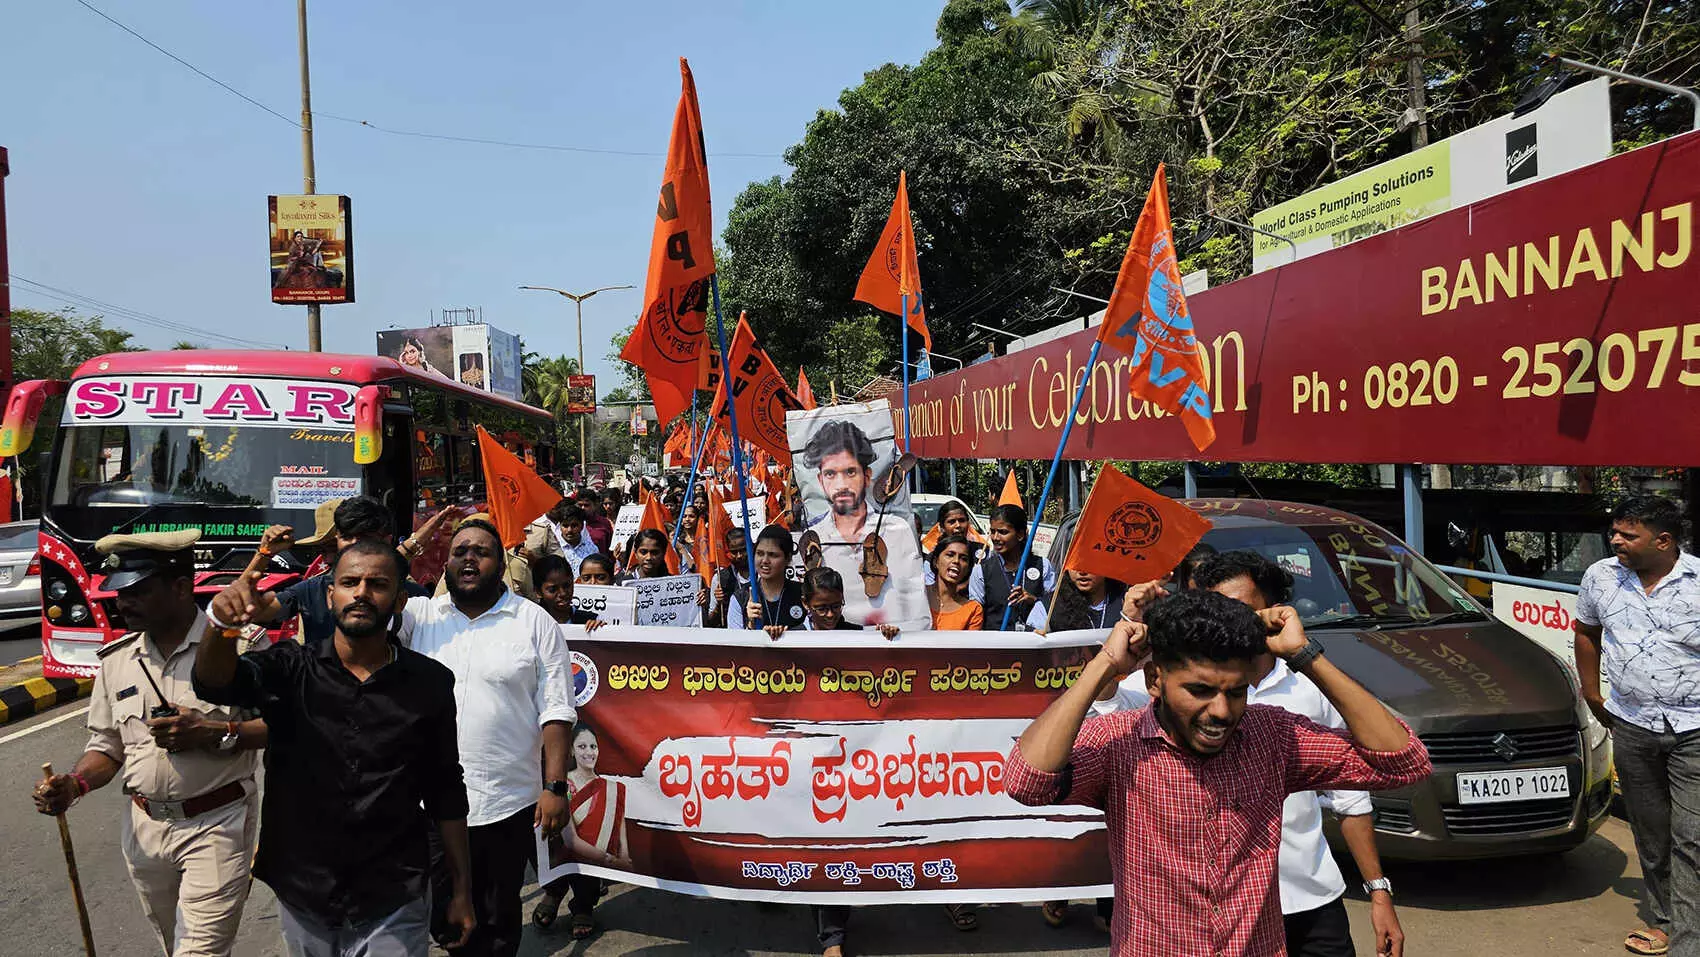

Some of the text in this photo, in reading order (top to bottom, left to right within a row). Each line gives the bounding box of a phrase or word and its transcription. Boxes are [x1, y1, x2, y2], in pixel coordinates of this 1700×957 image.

[1260, 165, 1434, 236] World Class Pumping Solutions
[1308, 224, 1314, 234] &
[1315, 215, 1349, 233] Domestic
[1350, 196, 1401, 220] Applications
[1421, 202, 1692, 316] BANNANJ
[1364, 356, 1459, 410] 0820
[74, 381, 356, 423] STAR
[950, 378, 967, 435] of
[971, 382, 1017, 450] your
[290, 428, 354, 443] Travels
[280, 465, 328, 475] MAIL
[205, 524, 235, 536] FAKIR
[1513, 600, 1576, 632] ಉಡು
[608, 664, 670, 691] ಅಖಿಲ
[683, 660, 806, 696] ಭಾರತೀಯ
[930, 662, 1022, 694] ಪರಿಷತ್
[659, 735, 792, 827] ಬೃಹತ್
[1470, 774, 1568, 798] KA20 P 1022
[922, 858, 959, 885] ಶಕ್ತಿ
